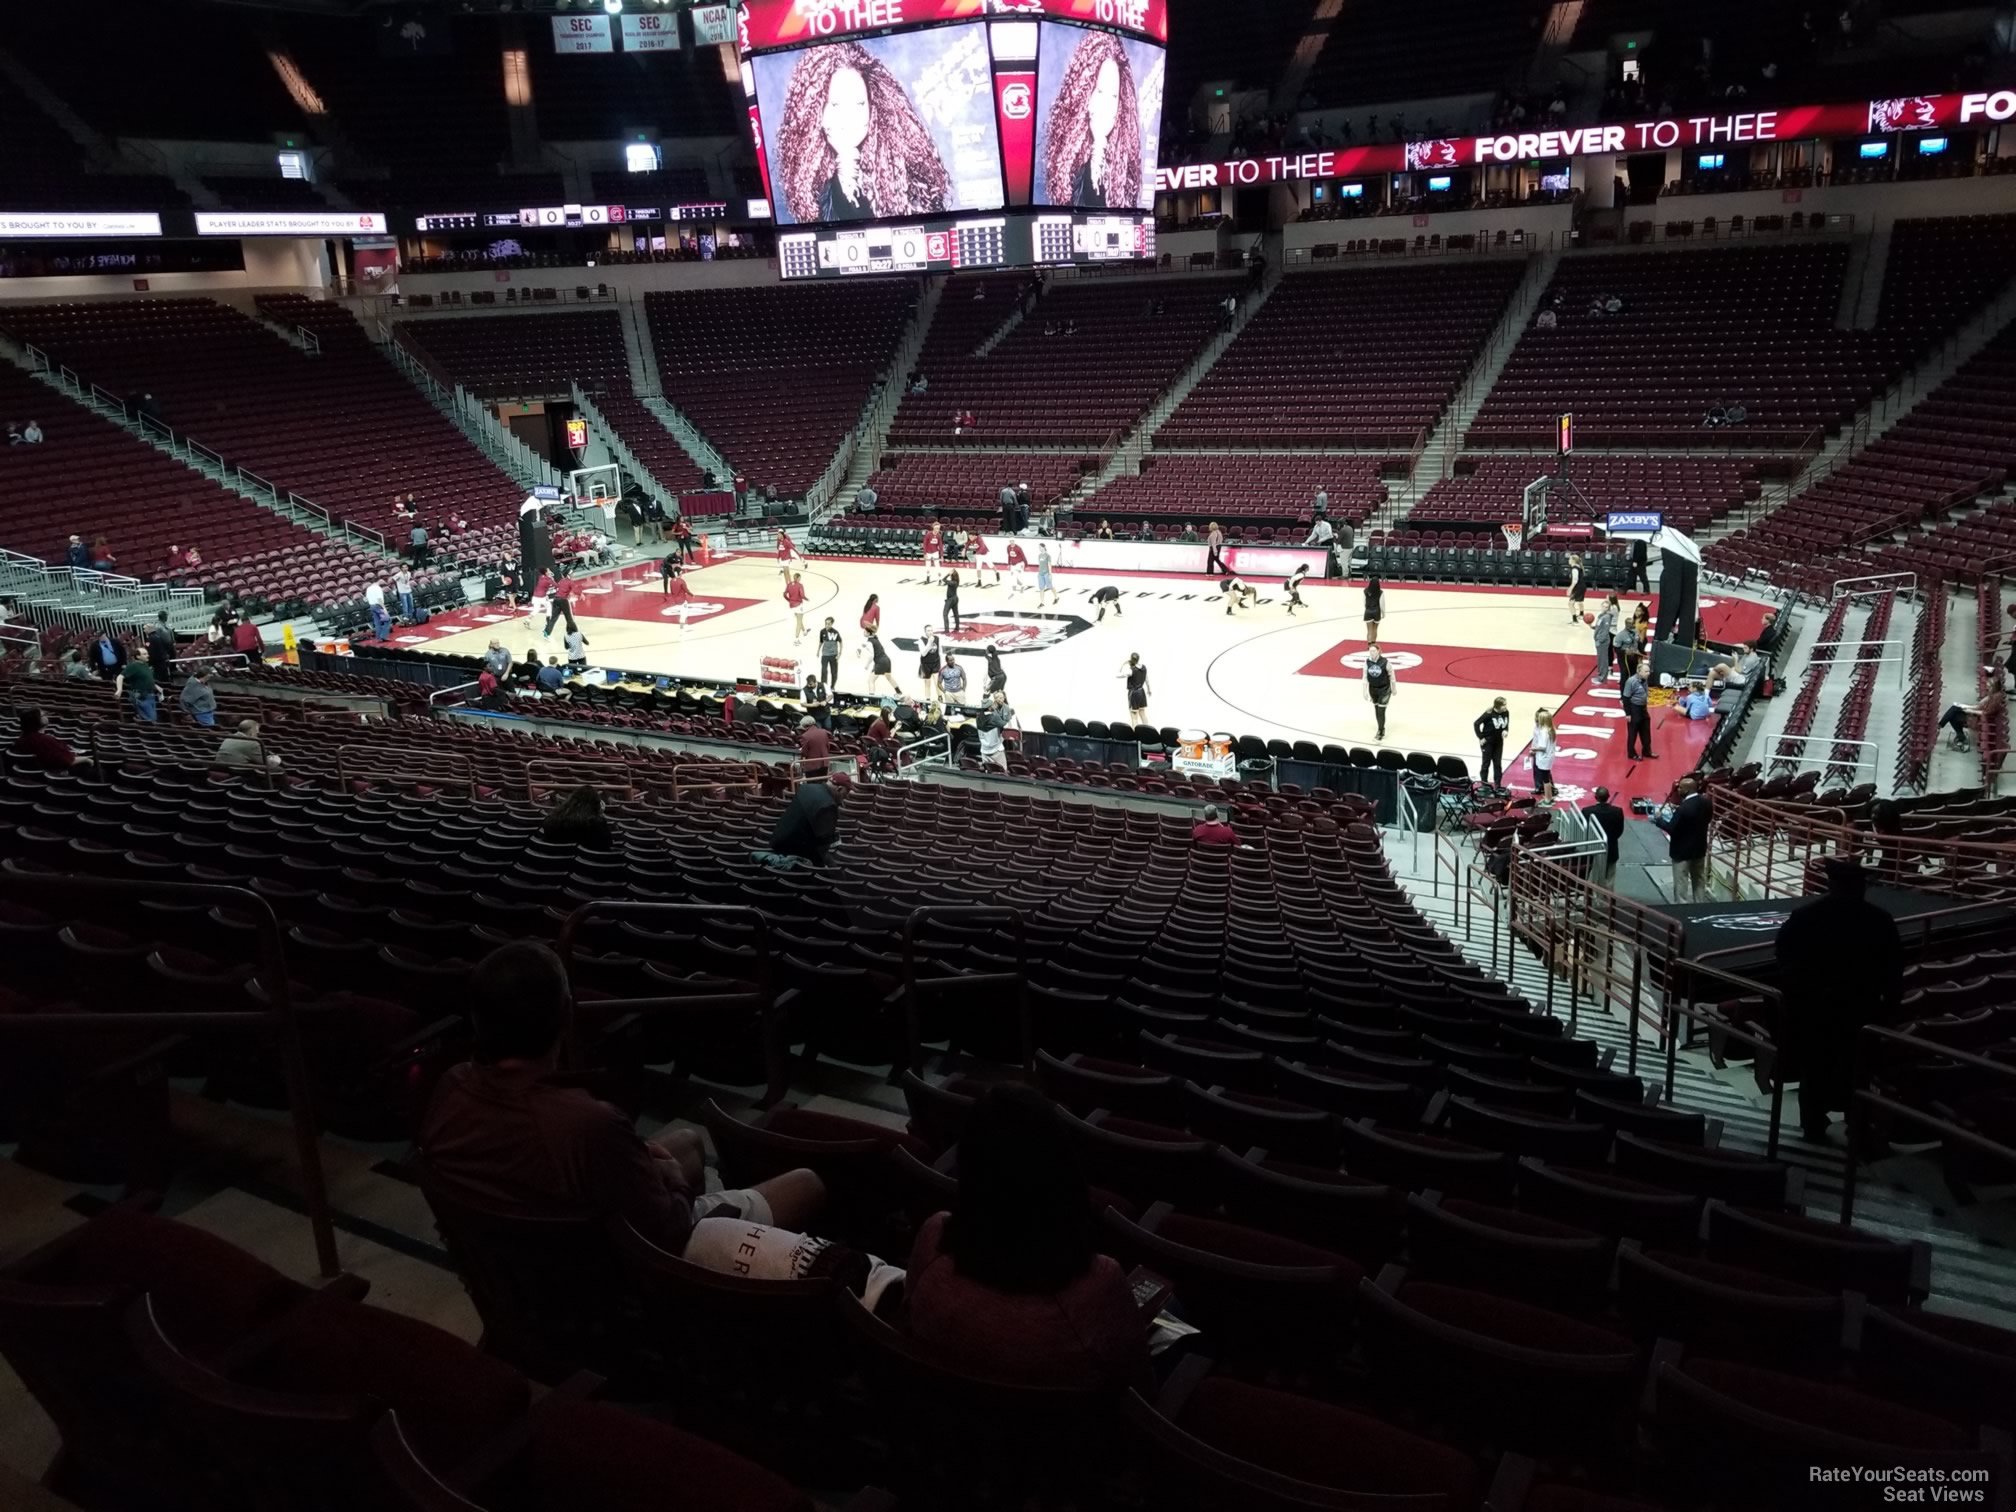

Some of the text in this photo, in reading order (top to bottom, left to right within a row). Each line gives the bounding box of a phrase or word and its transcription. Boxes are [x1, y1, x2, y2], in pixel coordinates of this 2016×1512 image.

[639, 16, 661, 30] SEC
[703, 8, 727, 24] NCAA
[805, 9, 837, 36] TO
[838, 1, 904, 30] THEE
[1095, 2, 1114, 22] TO
[1115, 2, 1145, 31] THEE
[570, 18, 593, 32] SEC
[575, 42, 592, 50] 2017
[1475, 112, 1777, 163] FOREVER TO THEE
[1225, 159, 1259, 184] TO
[1266, 152, 1335, 180] THEE
[547, 210, 557, 223] 0
[590, 209, 600, 221] 0
[848, 245, 858, 262] 0
[904, 240, 916, 258] 0
[572, 430, 585, 445] 30
[1609, 515, 1660, 527] ZAXBY'S
[505, 563, 516, 571] W
[828, 632, 838, 642] W
[1183, 760, 1214, 769] GATORADE
